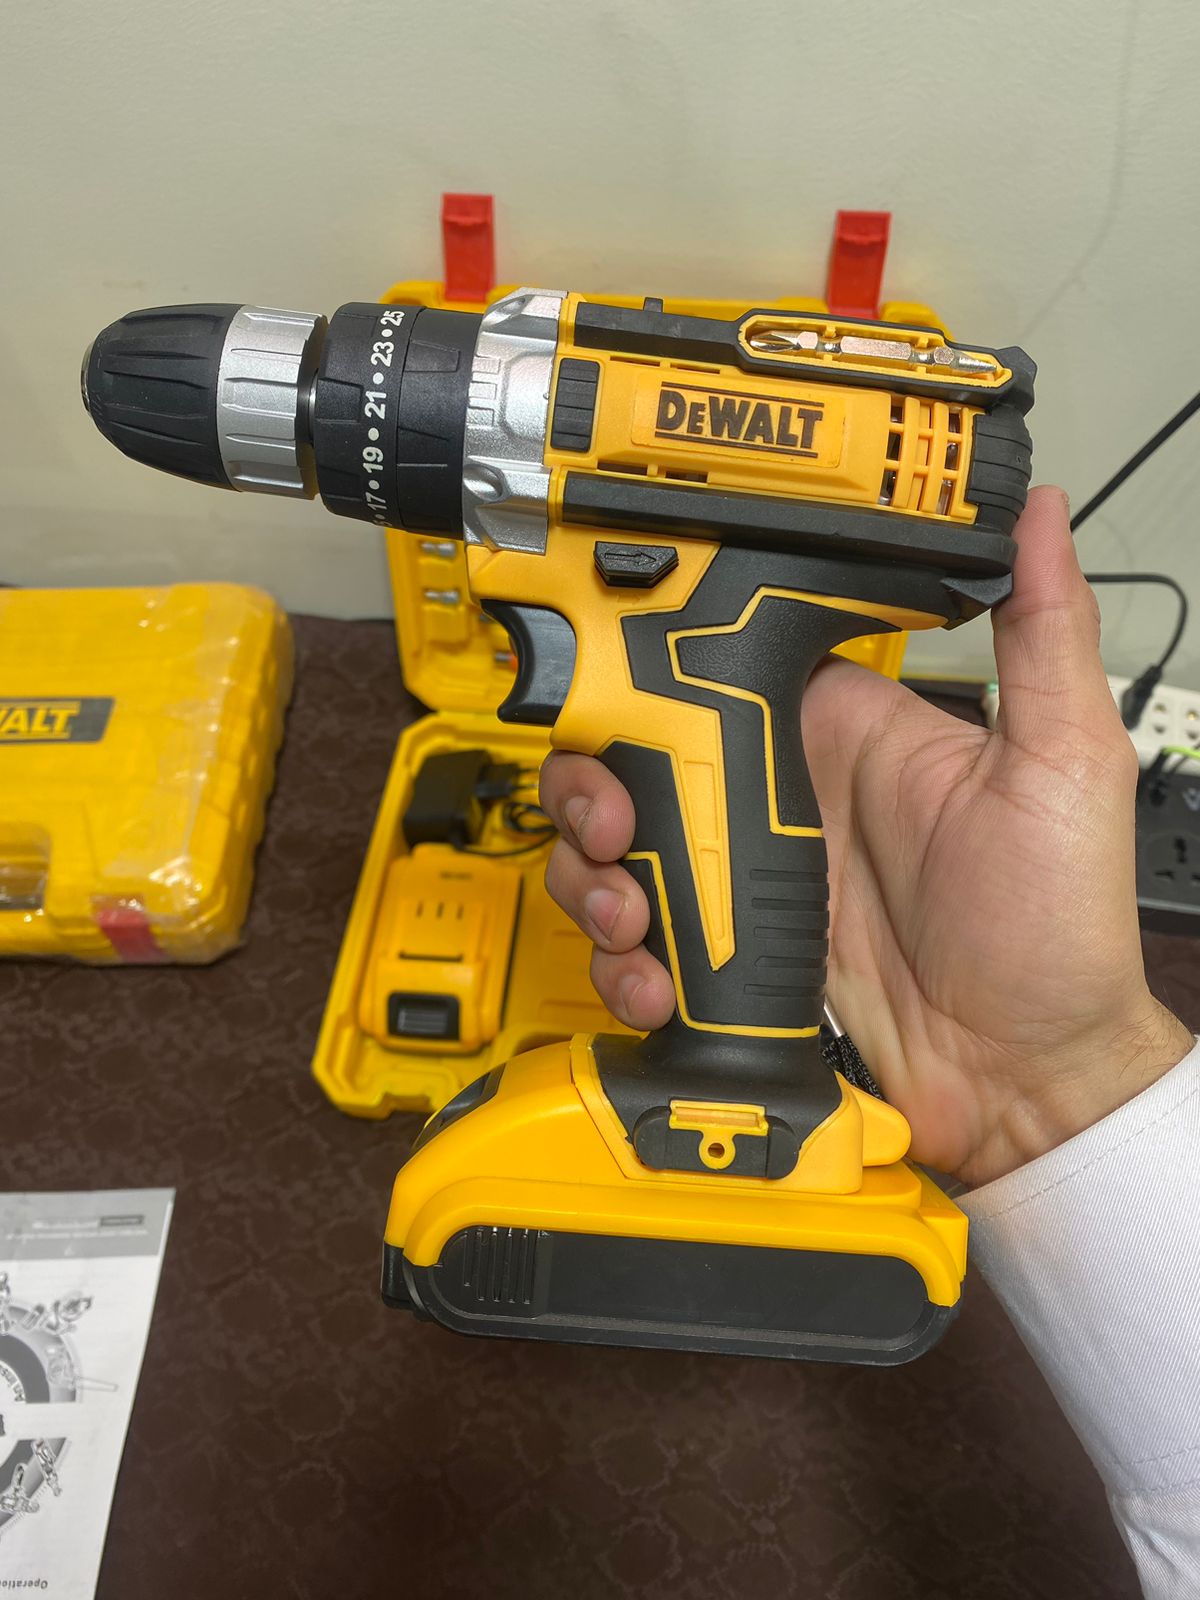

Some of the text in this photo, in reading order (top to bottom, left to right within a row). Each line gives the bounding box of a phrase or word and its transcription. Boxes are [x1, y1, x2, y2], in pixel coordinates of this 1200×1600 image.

[380, 310, 405, 327] 25
[370, 341, 395, 367] 23
[364, 391, 387, 420] 21
[362, 446, 384, 474] 19
[365, 491, 388, 511] 17
[0, 1578, 49, 1590] Operatio
